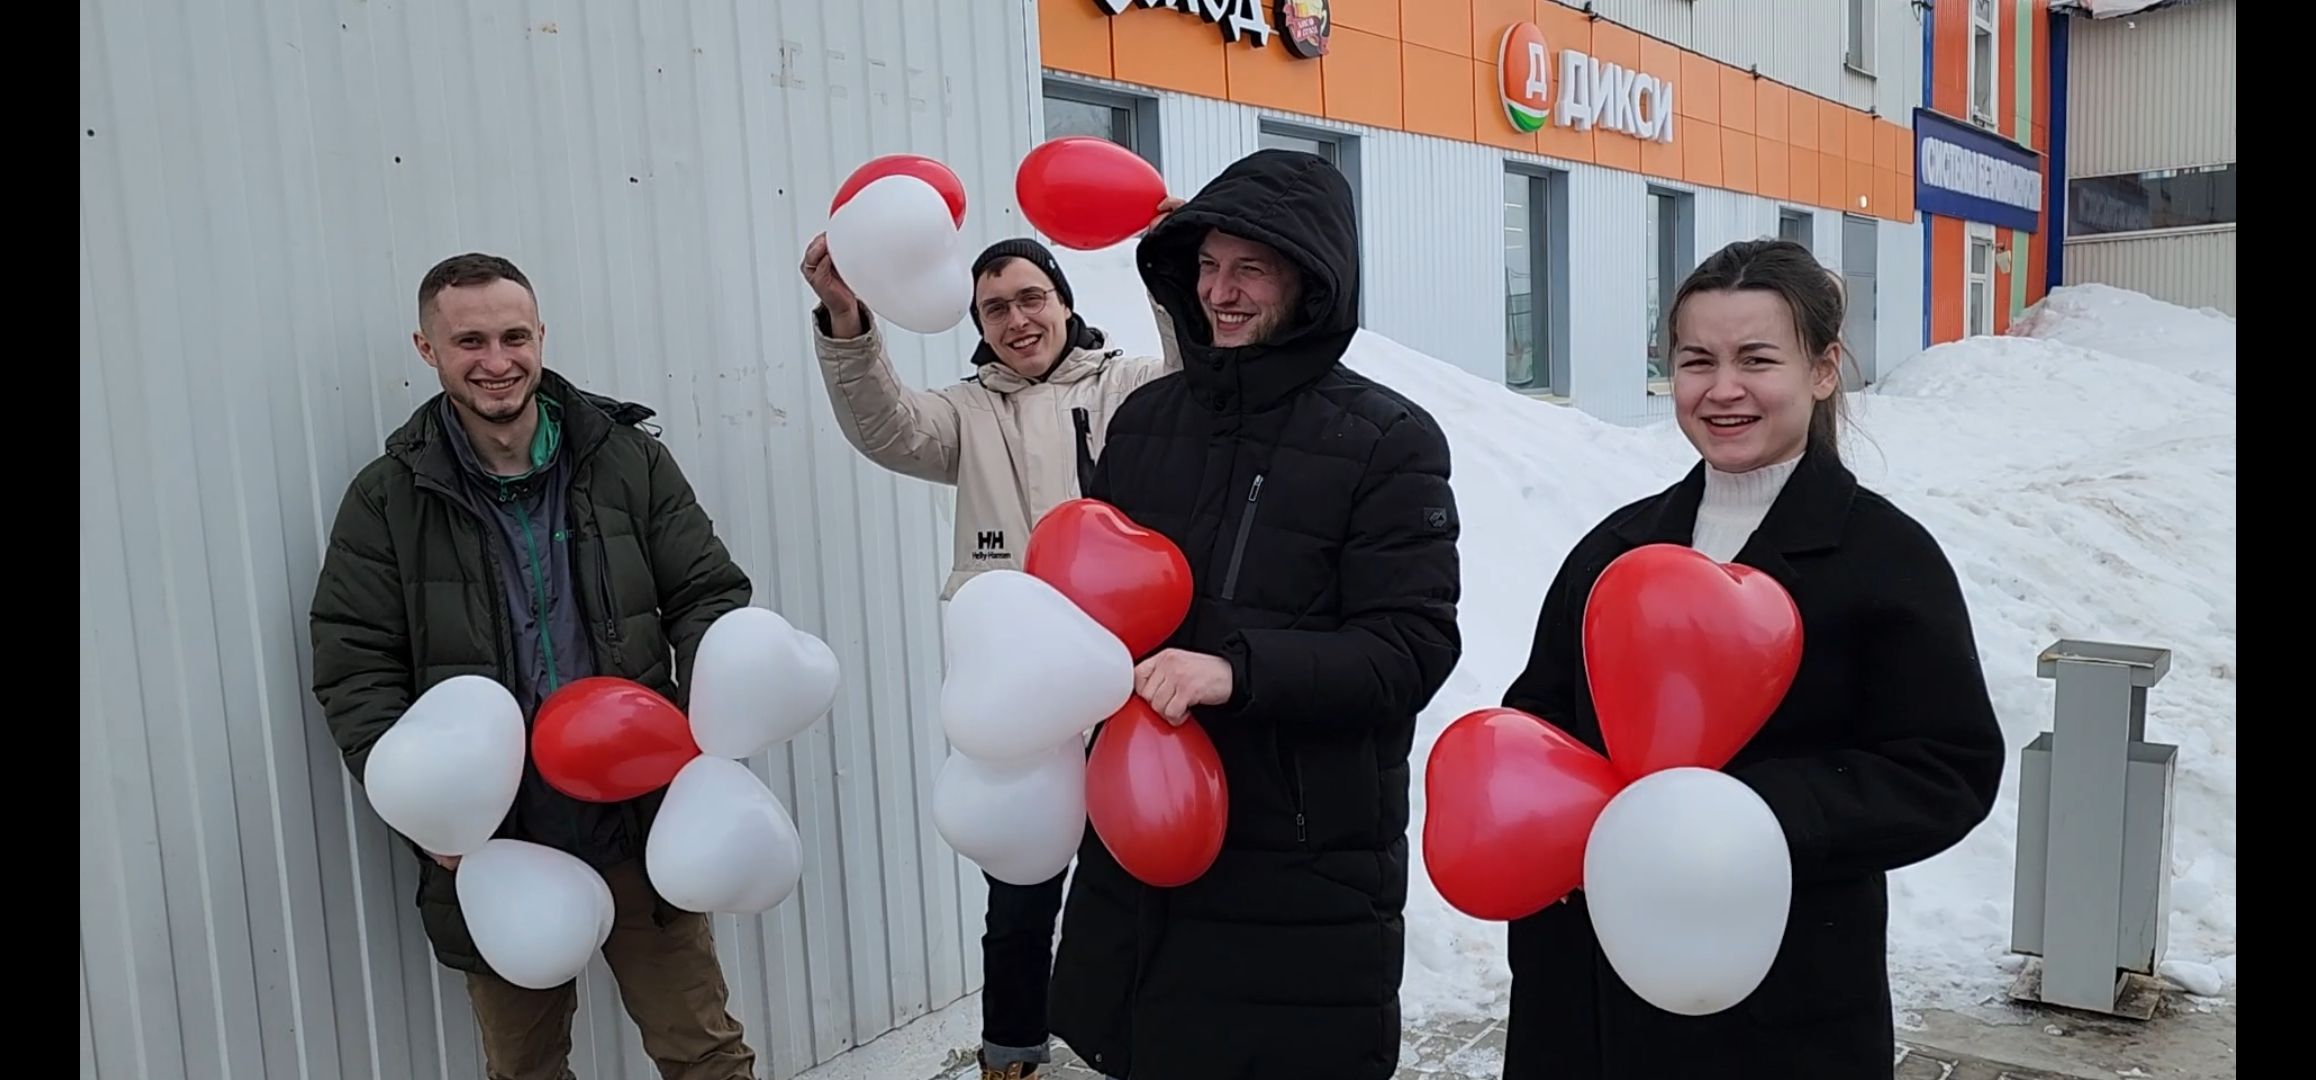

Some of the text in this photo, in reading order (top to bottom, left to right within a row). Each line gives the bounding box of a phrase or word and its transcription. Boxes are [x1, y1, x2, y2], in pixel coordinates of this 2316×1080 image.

[1555, 49, 1673, 144] ДИКСИ
[1921, 137, 1977, 196] СИСТЕМЫ
[978, 530, 1004, 550] HH
